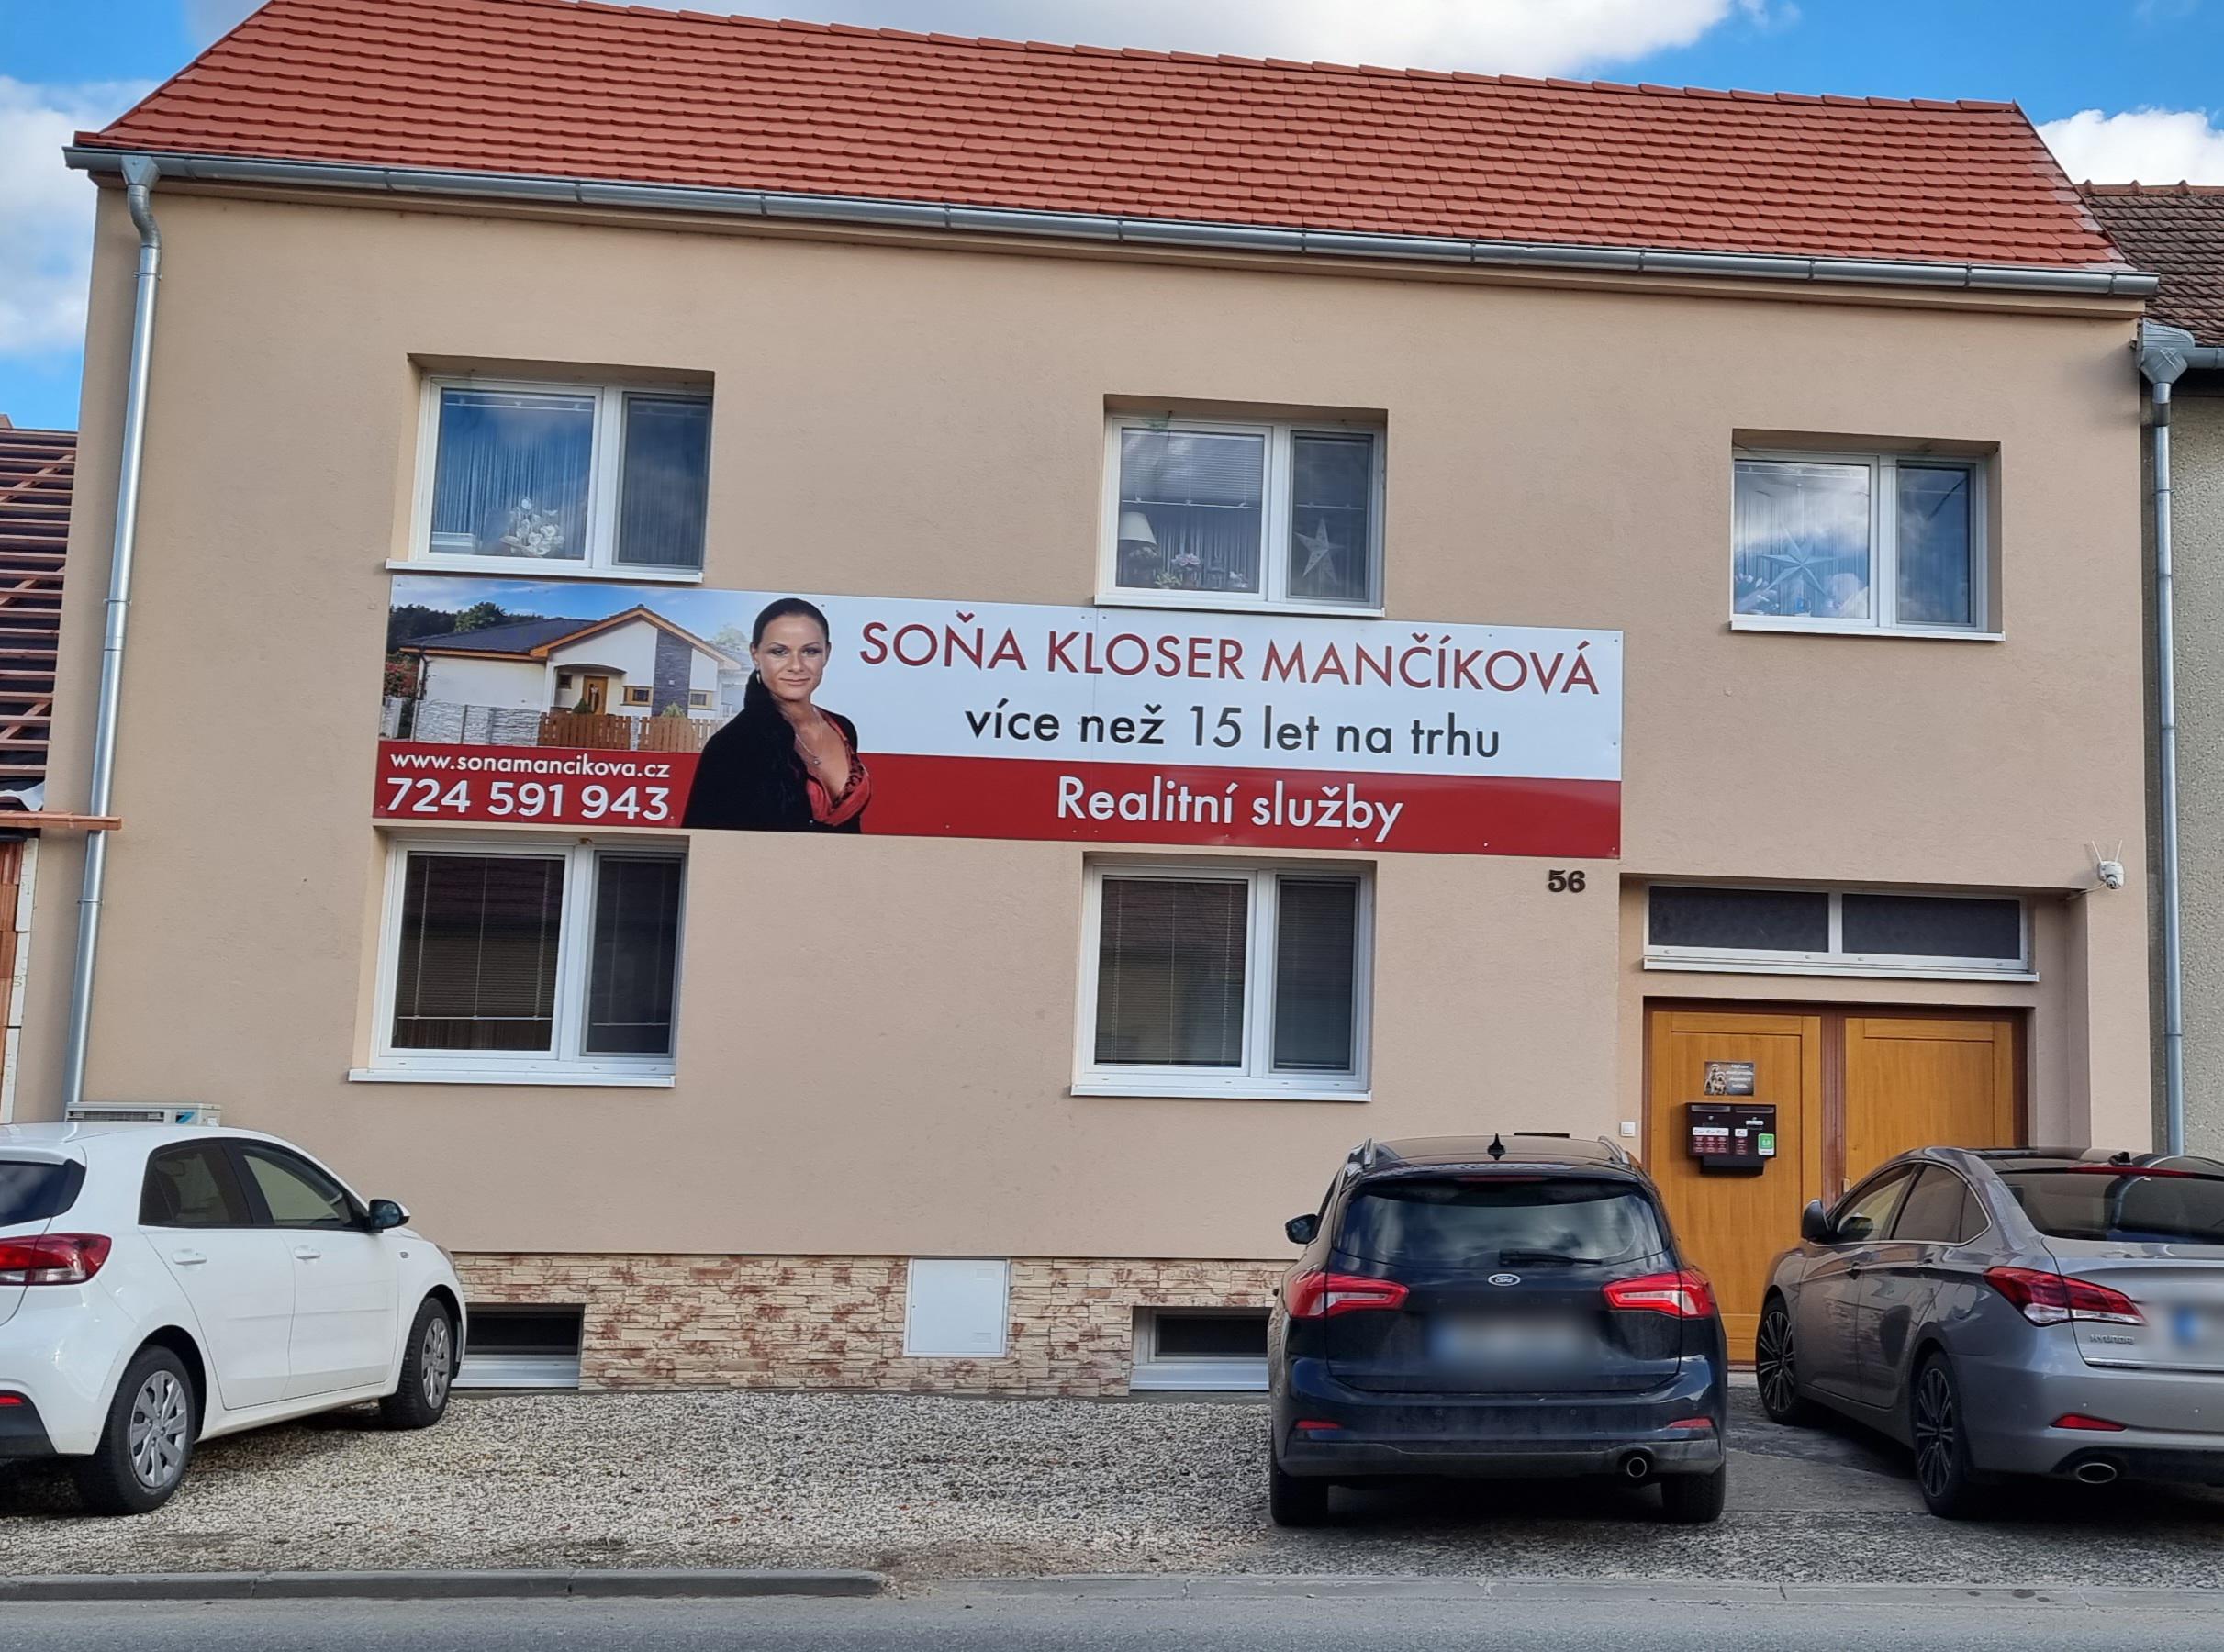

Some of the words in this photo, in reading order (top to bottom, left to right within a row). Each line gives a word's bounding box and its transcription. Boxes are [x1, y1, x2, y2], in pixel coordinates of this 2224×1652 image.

[859, 609, 1027, 671] SOŇA
[1047, 631, 1245, 680] KLOSER
[1261, 632, 1599, 695] MANČÍKOVÁ
[965, 698, 1059, 741] více
[1079, 703, 1166, 745] než
[1190, 706, 1242, 748] 15
[1263, 705, 1319, 751] let
[1336, 725, 1391, 753] na
[1411, 712, 1499, 757] trhu
[390, 751, 670, 778] www.sonamancikova.cz
[386, 777, 471, 814] 724
[488, 782, 563, 817] 591
[580, 786, 669, 820] 943
[1057, 776, 1237, 824] Realitní
[1251, 780, 1403, 843] služby
[1548, 870, 1586, 893] 56
